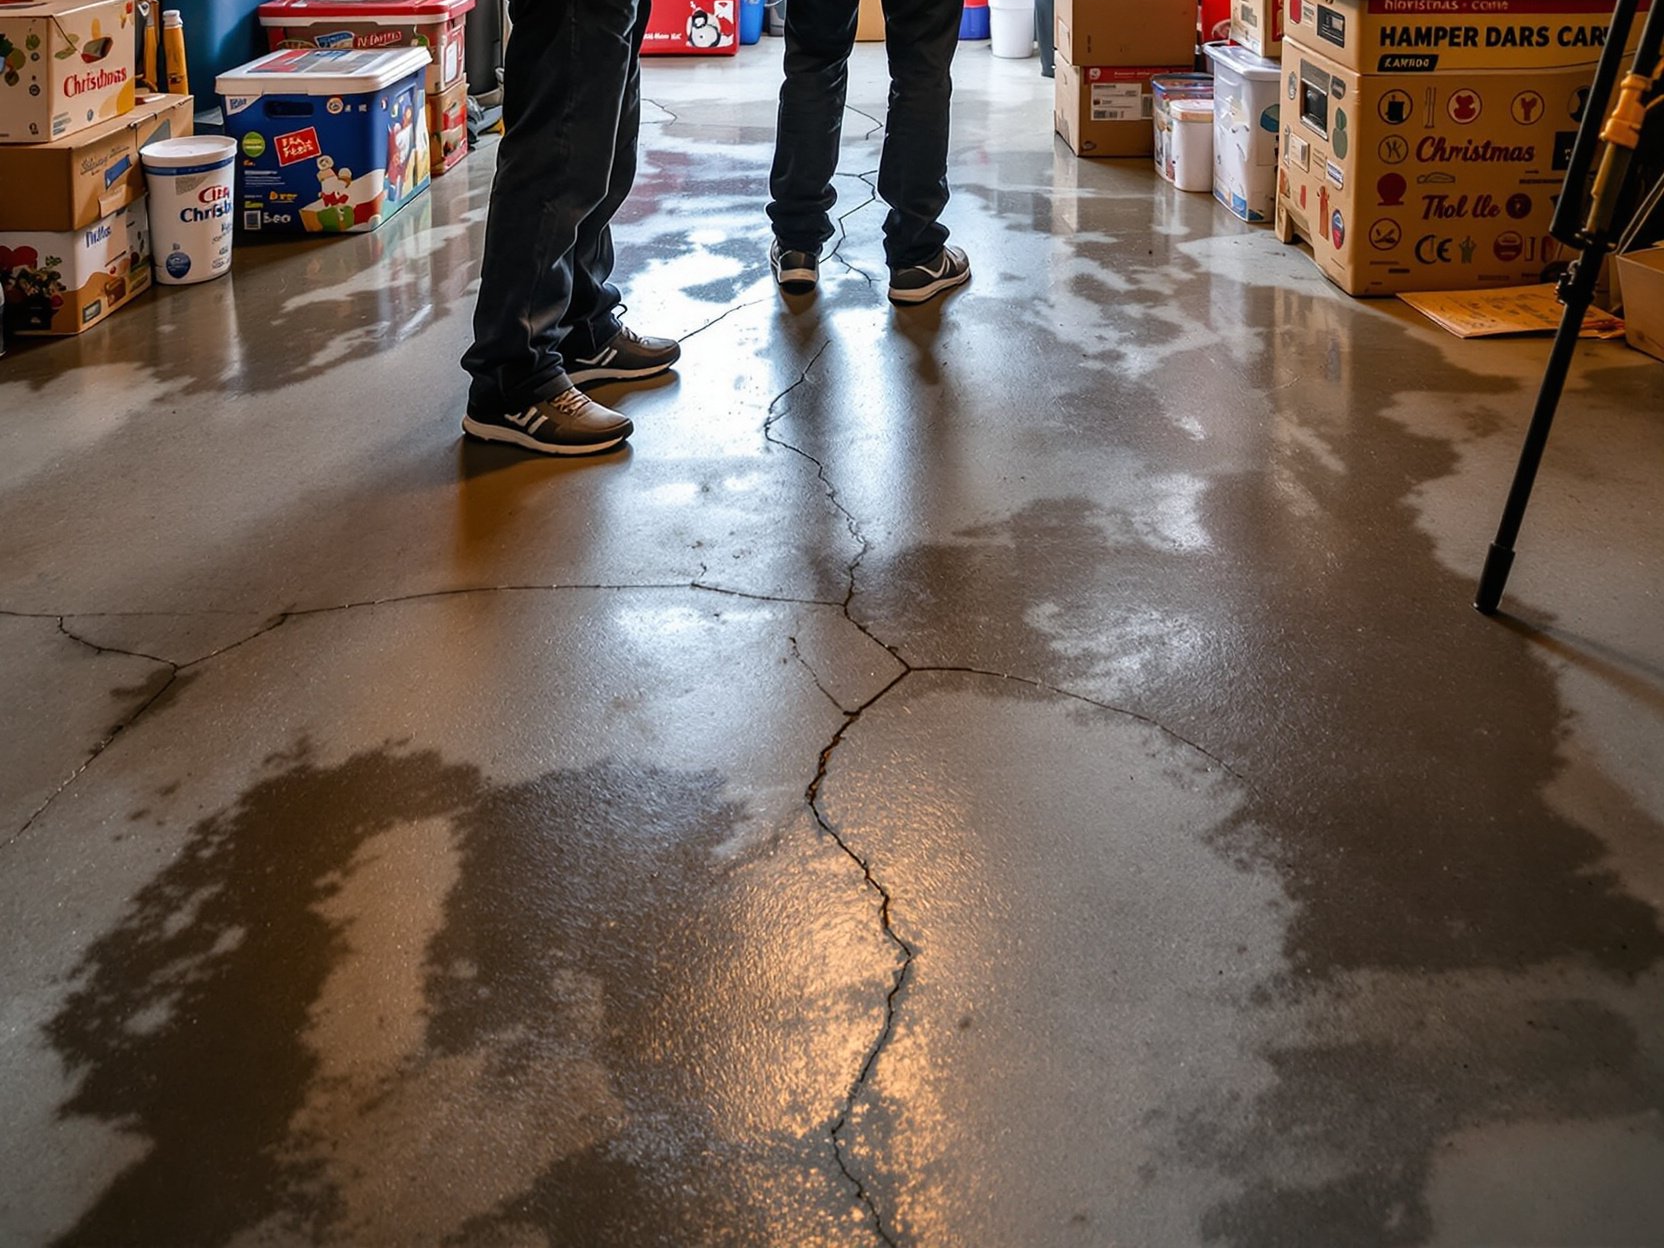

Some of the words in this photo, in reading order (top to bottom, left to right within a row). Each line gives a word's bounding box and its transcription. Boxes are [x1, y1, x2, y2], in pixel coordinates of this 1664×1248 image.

[1380, 26, 1479, 48] HAMPER
[1485, 26, 1550, 48] DARS
[1415, 136, 1535, 163] Christmas
